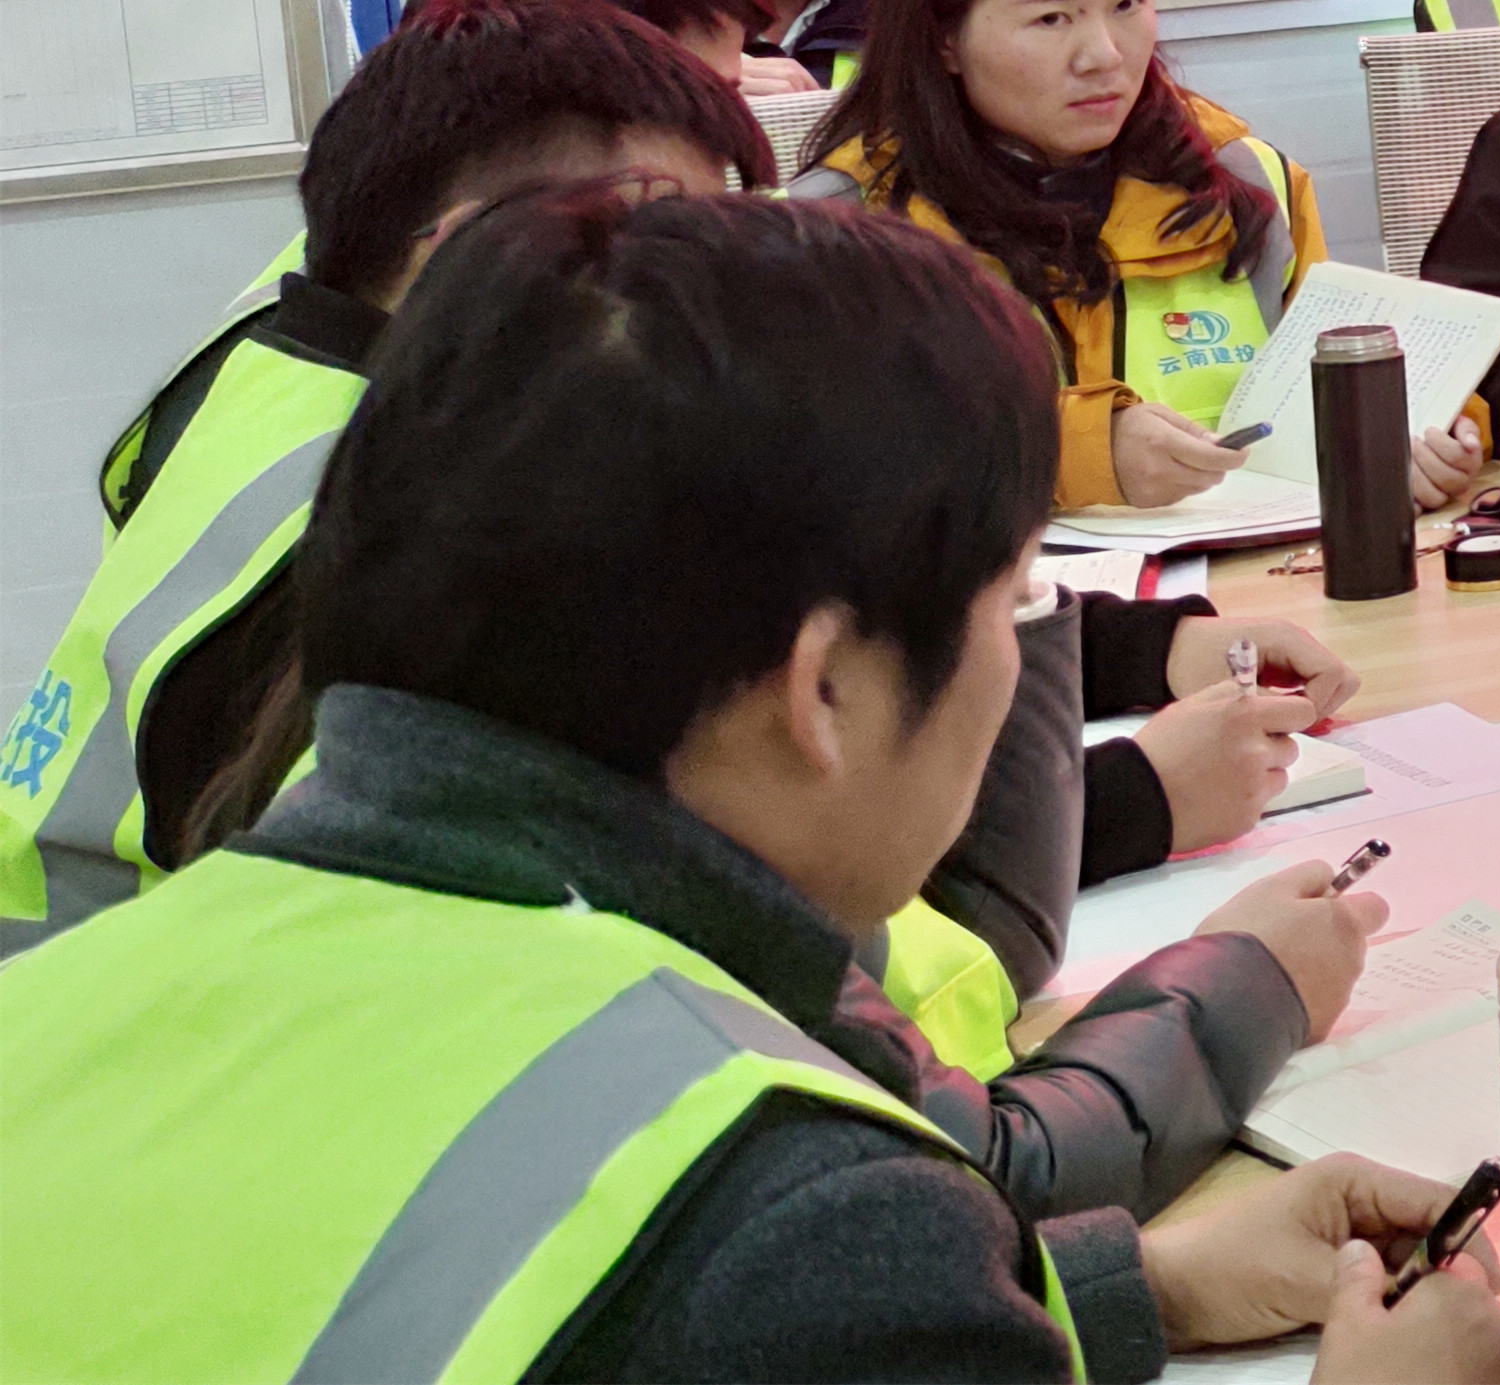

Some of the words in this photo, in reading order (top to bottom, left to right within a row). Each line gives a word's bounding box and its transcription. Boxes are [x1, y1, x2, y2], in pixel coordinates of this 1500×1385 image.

[1158, 344, 1256, 375] 云南建投
[1, 670, 72, 801] 投
